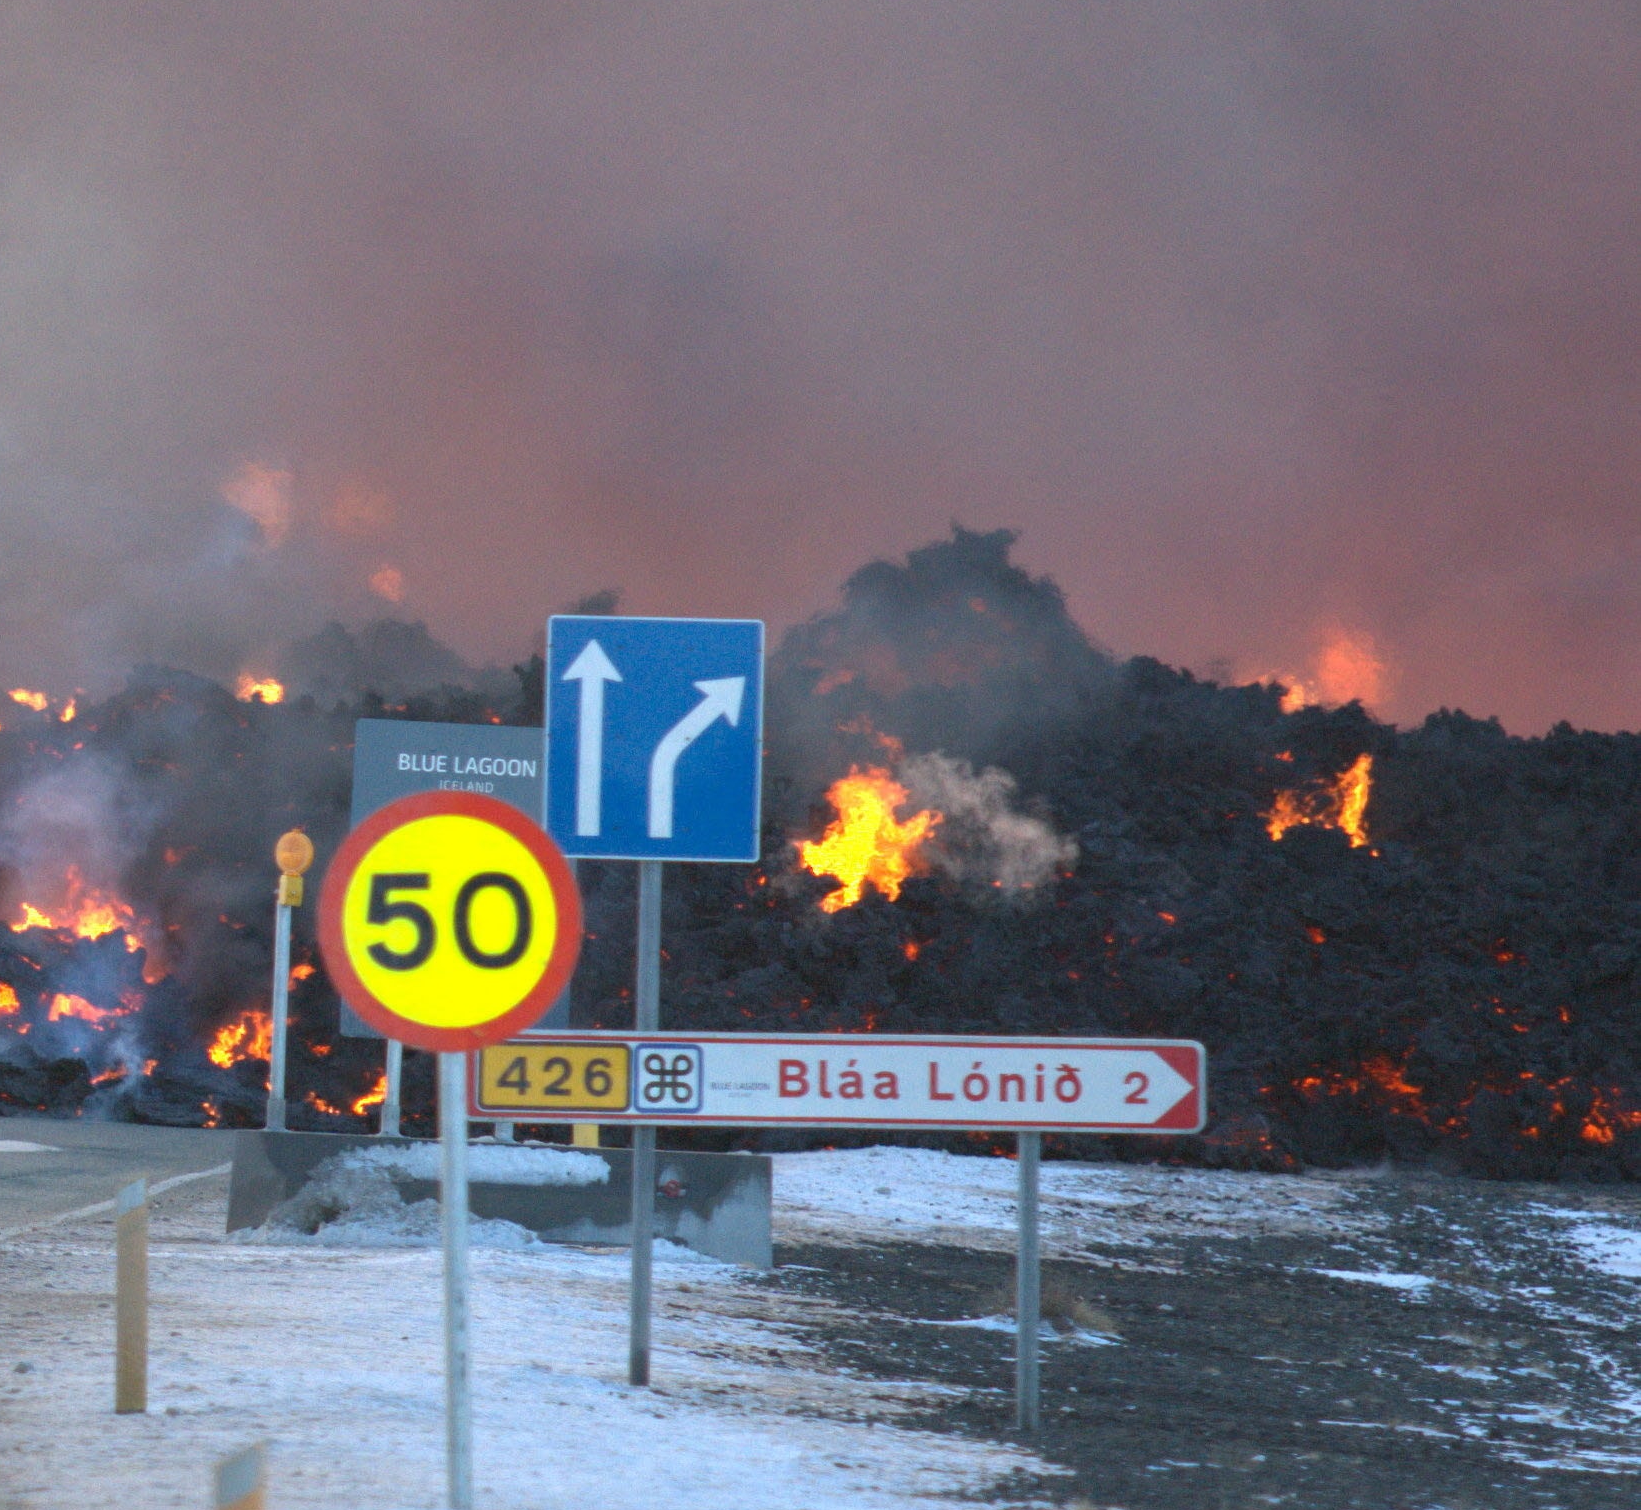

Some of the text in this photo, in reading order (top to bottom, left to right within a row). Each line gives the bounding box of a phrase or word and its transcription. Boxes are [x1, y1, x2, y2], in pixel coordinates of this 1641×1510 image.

[397, 753, 537, 778] BLUE LAGOON
[438, 779, 495, 794] ICELAND
[366, 871, 533, 971] 50
[497, 1055, 613, 1098] 426
[777, 1058, 1150, 1105] Bláa Lónið 2
